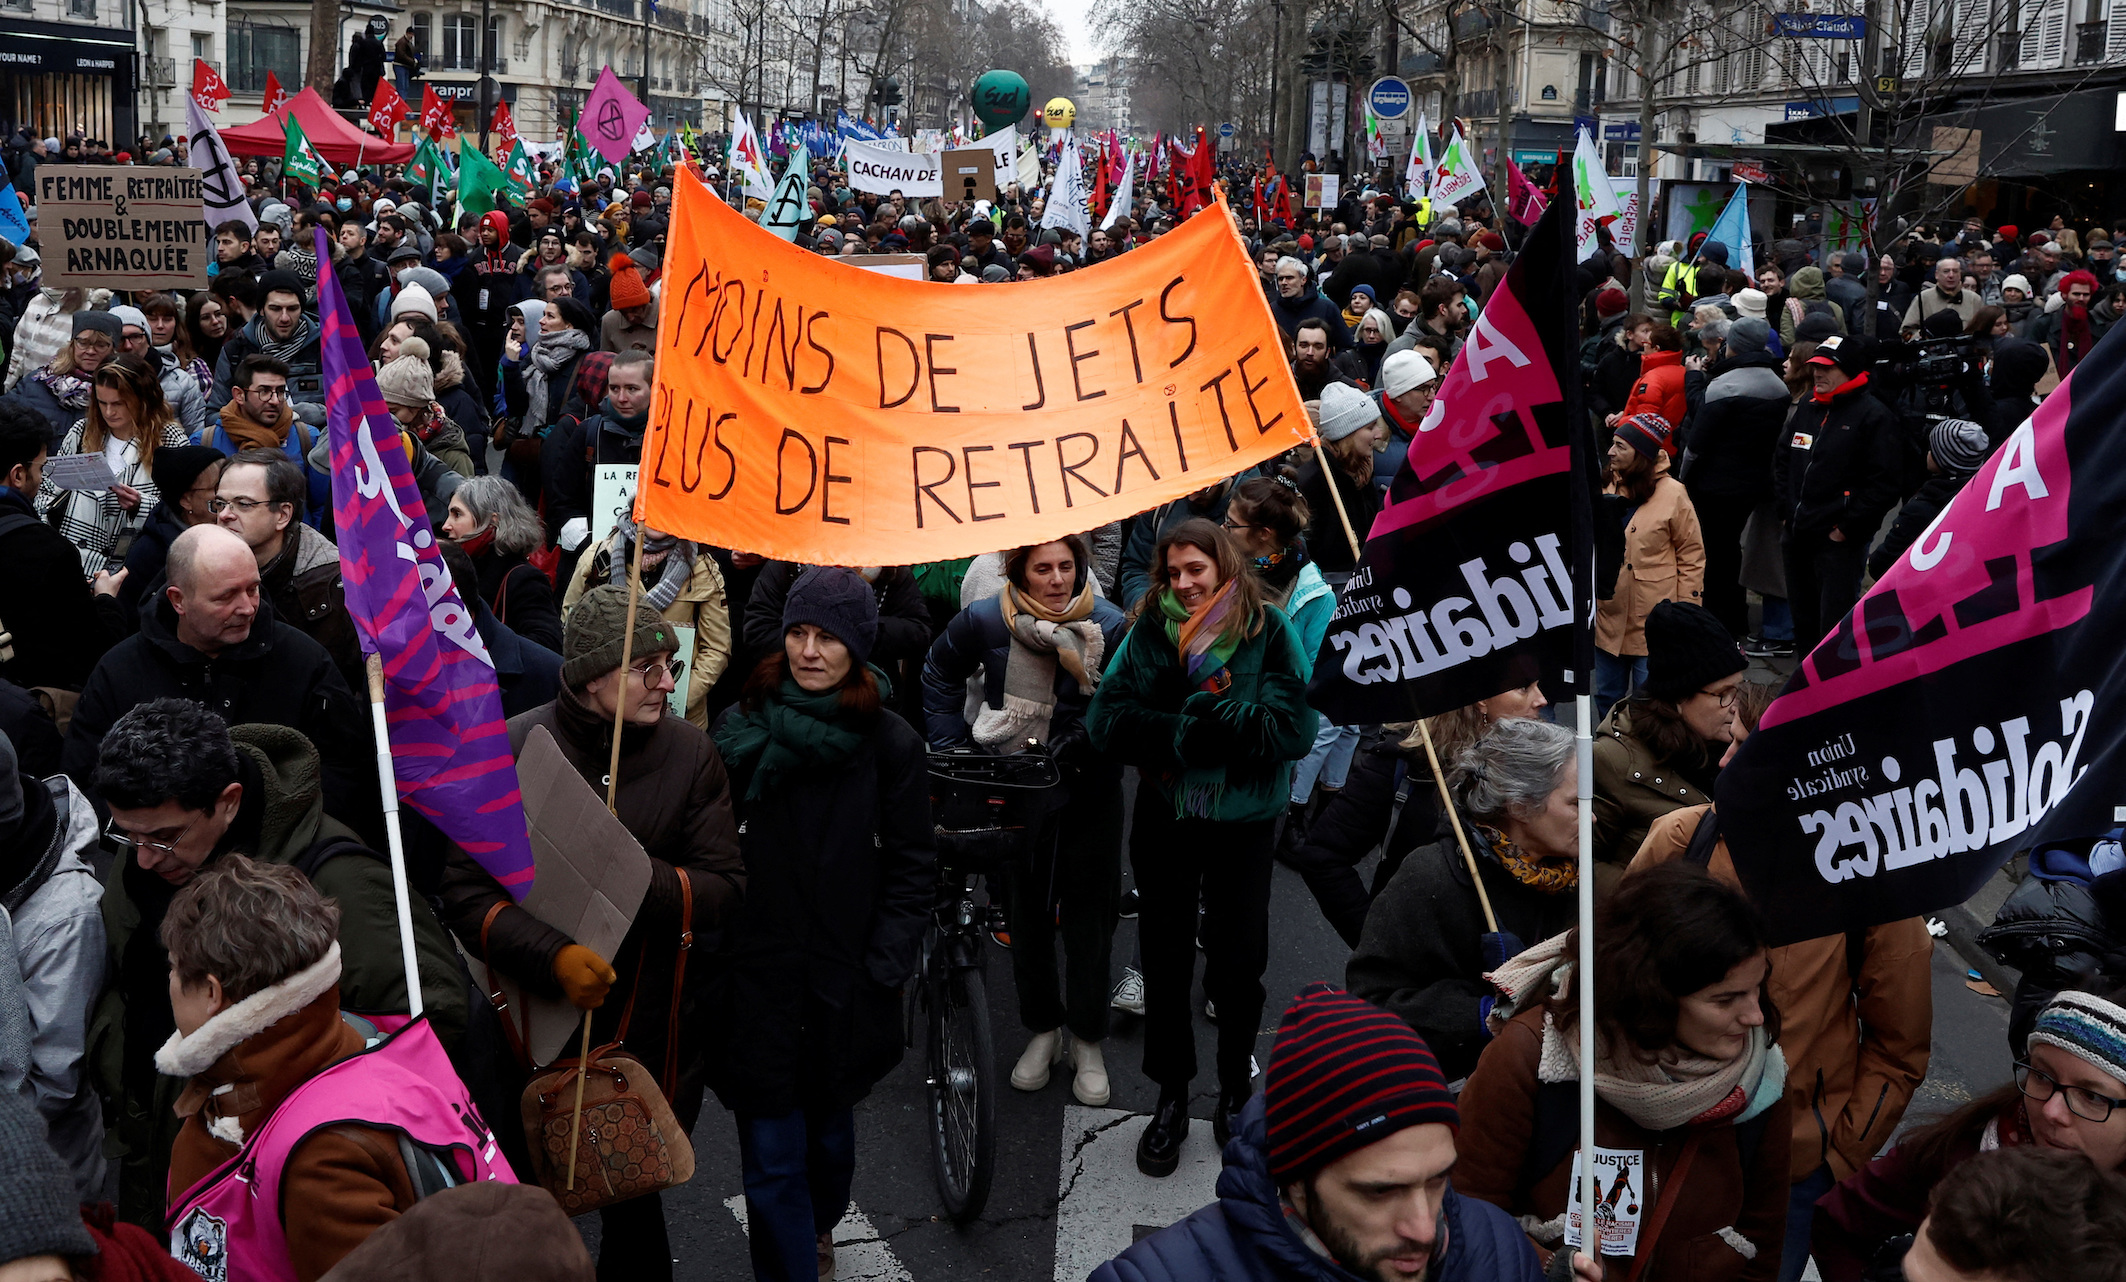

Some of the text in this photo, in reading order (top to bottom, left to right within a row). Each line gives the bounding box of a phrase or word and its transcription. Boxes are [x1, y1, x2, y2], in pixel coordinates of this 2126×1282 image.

[371, 20, 386, 30] BUS
[17, 53, 37, 64] NAME
[76, 58, 91, 67] LEON
[95, 60, 115, 69] HARPER
[432, 84, 473, 99] ranpr
[1882, 79, 1897, 91] 91
[985, 86, 1019, 107] Sud
[853, 160, 914, 182] CACHAN
[917, 169, 937, 181] DE
[42, 176, 113, 200] FEMME
[115, 194, 128, 216] &
[62, 218, 203, 243] DOUBLEMENT
[67, 244, 188, 272] ARNAQUÉE
[673, 258, 1197, 413] MOINS DE JETS
[776, 427, 852, 525] DE
[912, 346, 1283, 529] RETRAITE
[604, 471, 617, 480] LA
